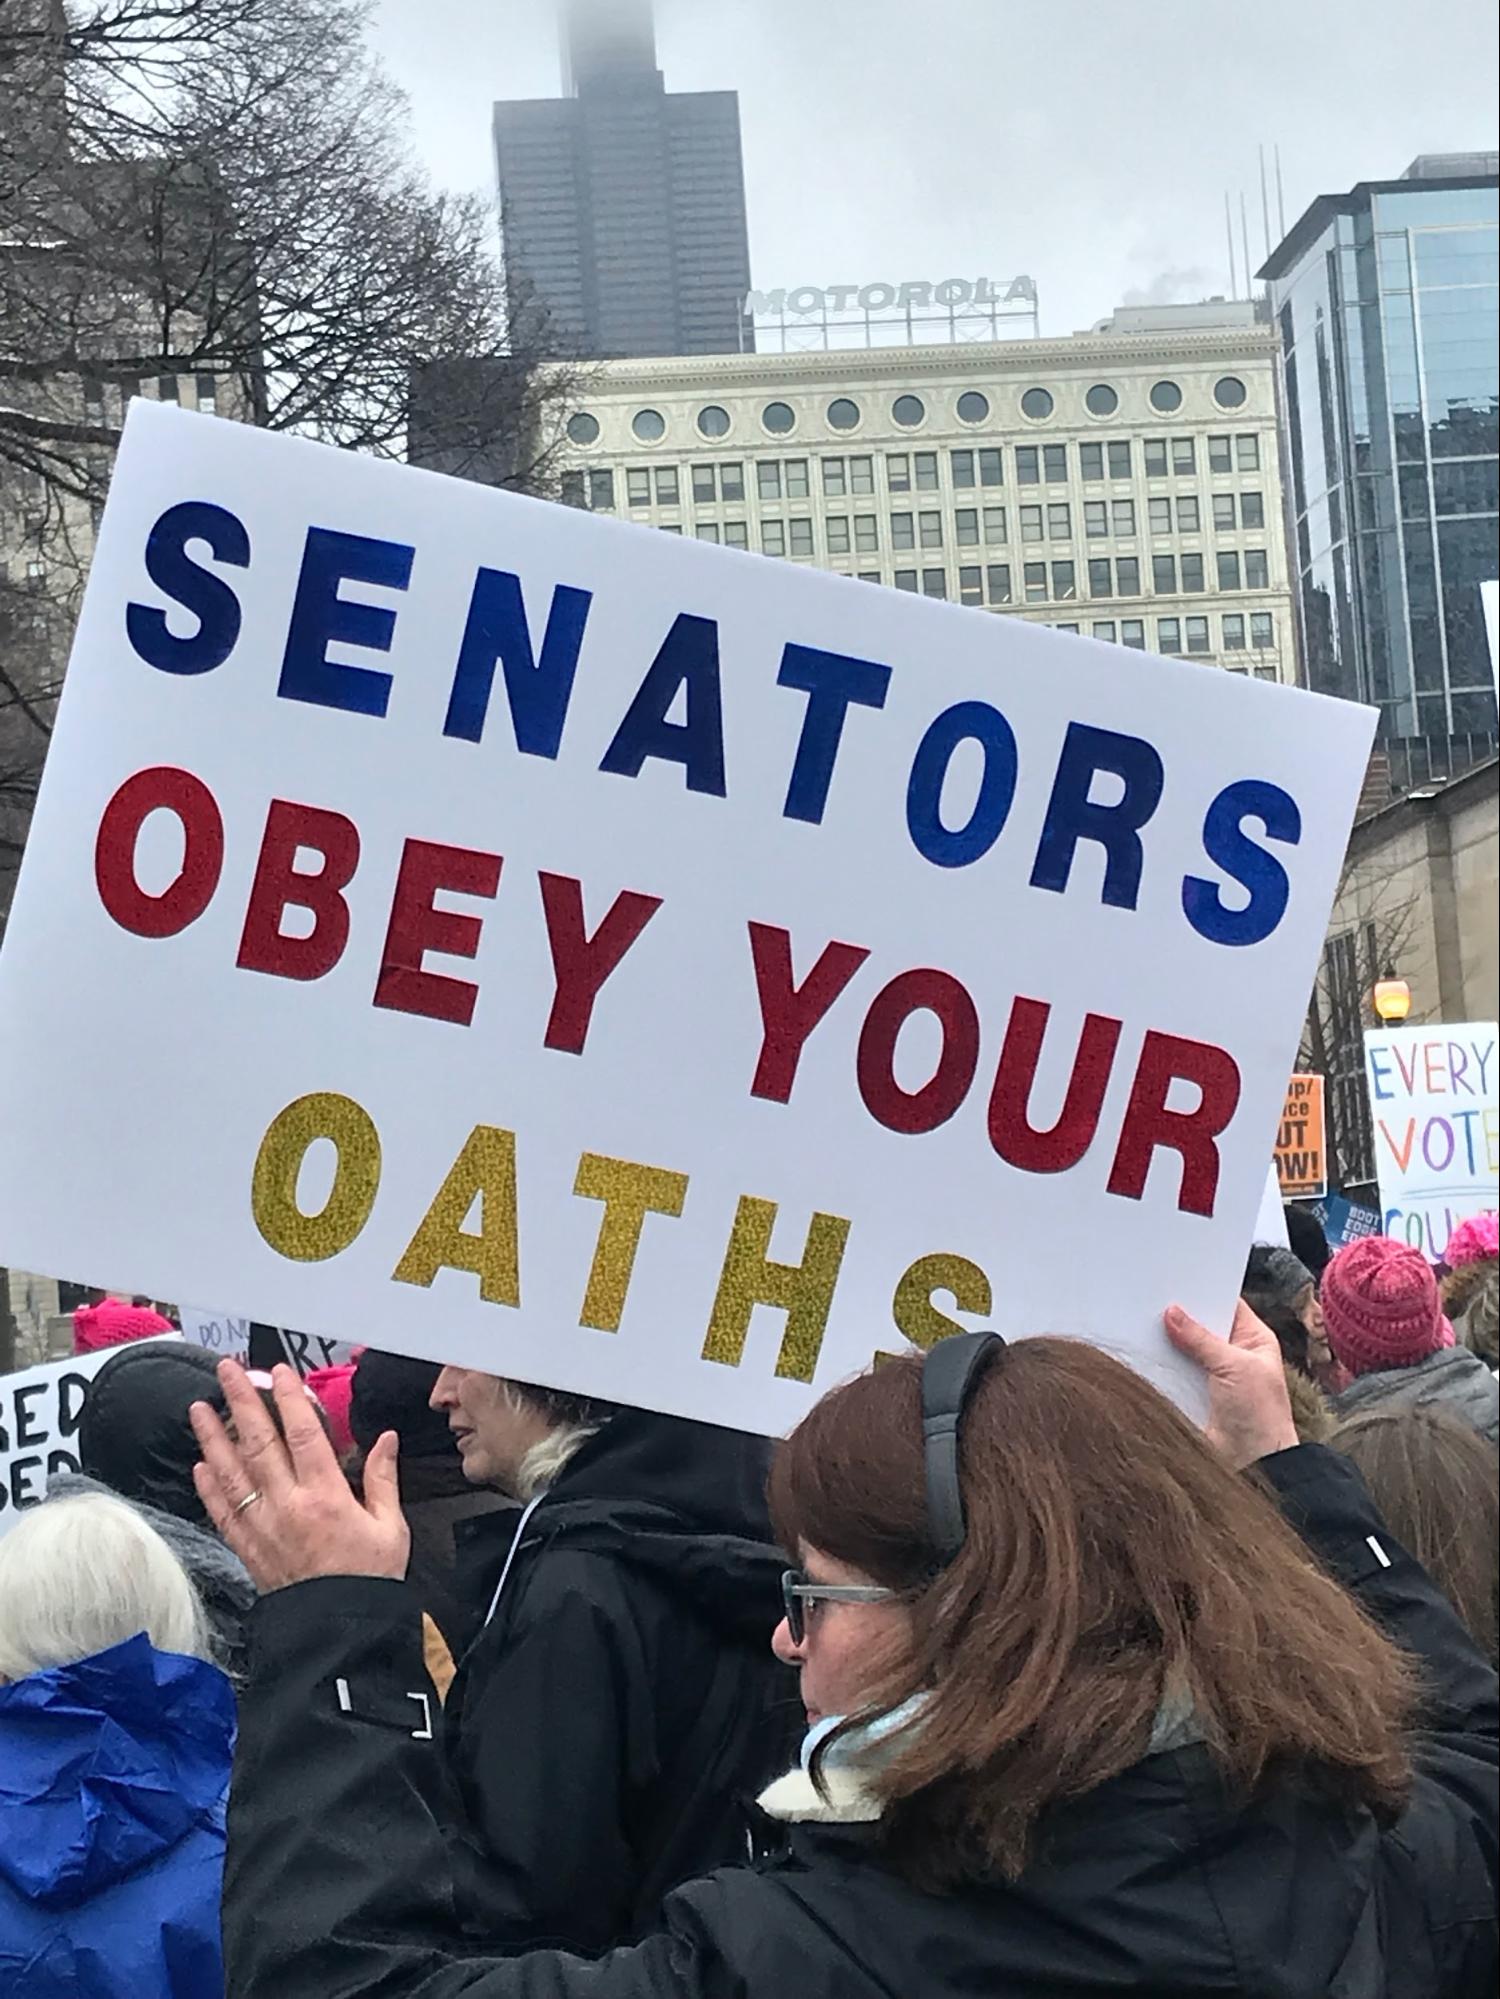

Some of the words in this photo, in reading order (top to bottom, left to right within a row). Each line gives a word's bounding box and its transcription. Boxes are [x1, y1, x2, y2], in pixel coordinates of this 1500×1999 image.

[744, 275, 1036, 316] MOTOROLA
[126, 501, 1302, 947] SENATORS
[95, 766, 664, 1055] OBEY
[747, 920, 1241, 1219] YOUR
[1368, 1040, 1496, 1100] EVERY
[1282, 1101, 1310, 1118] ce
[1378, 1107, 1499, 1177] VOTE
[251, 1091, 993, 1384] OATHS
[0, 1372, 93, 1453] ED
